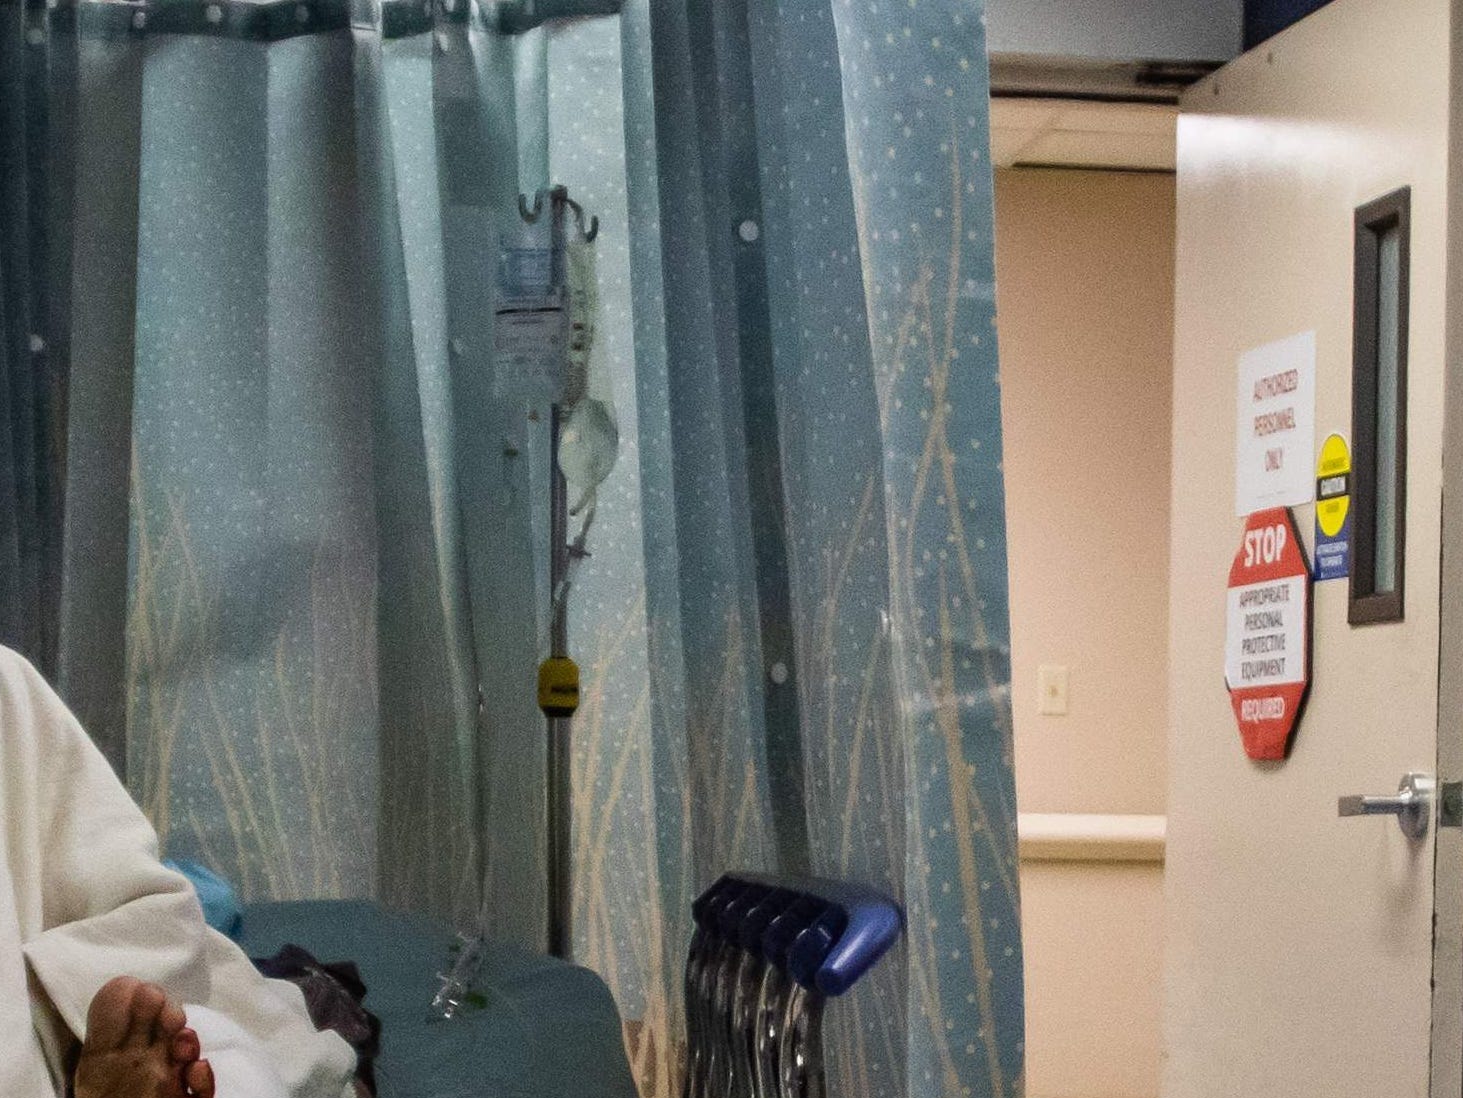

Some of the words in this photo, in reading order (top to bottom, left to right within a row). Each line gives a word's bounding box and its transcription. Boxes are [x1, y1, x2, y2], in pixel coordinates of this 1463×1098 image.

[1254, 368, 1298, 400] AUTHORIZED
[1254, 407, 1296, 436] PERSONNEL
[1265, 447, 1283, 472] ONLY
[1244, 524, 1287, 568] STOP
[1240, 584, 1290, 608] APPROPRIATE
[1244, 611, 1284, 630] PERSONAL
[1242, 633, 1286, 656] PROTECTIVE
[1241, 657, 1286, 680] EQUIPMENT
